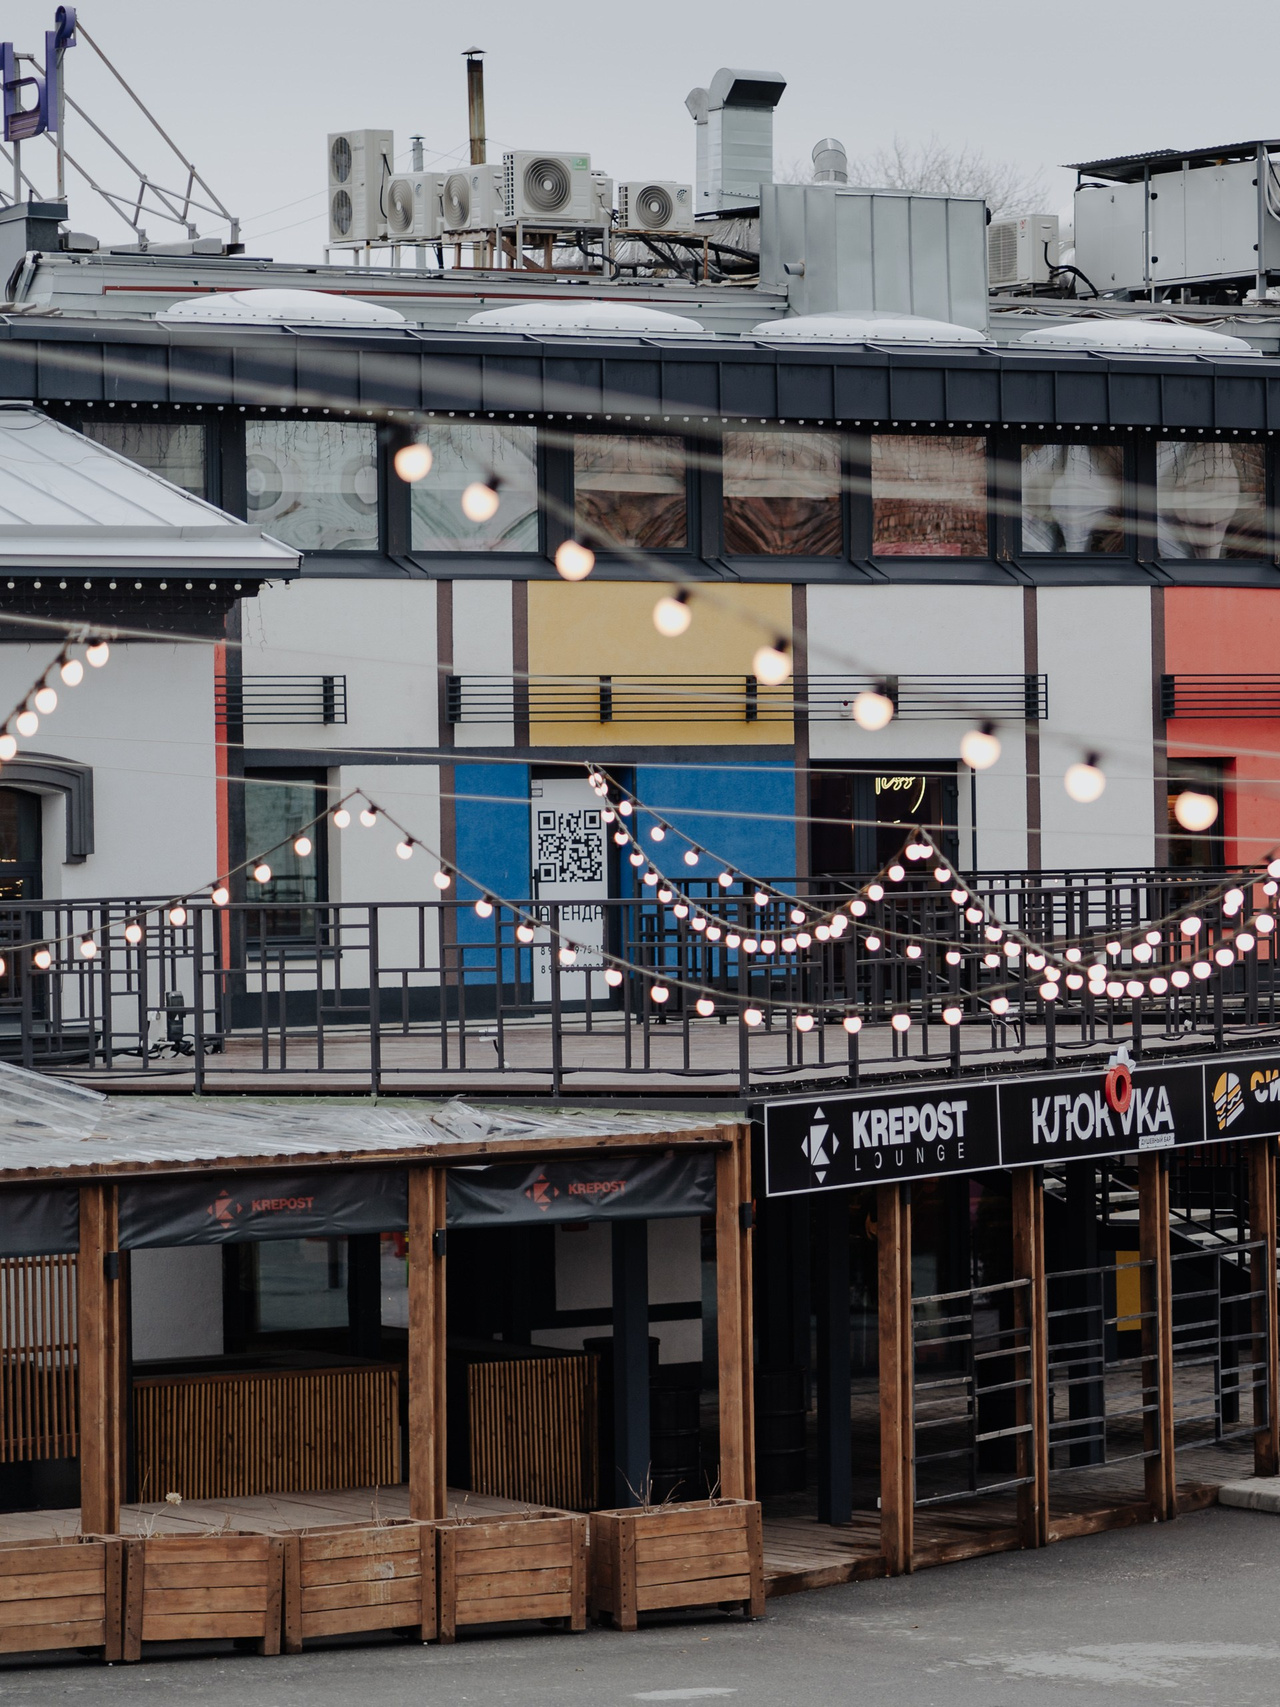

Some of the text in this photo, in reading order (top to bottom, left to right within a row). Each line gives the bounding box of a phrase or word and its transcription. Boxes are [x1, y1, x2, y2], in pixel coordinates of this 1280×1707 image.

[540, 904, 604, 922] АЕНДА
[852, 1100, 968, 1149] KREPOST
[854, 1142, 965, 1171] LOUNGE
[567, 1180, 627, 1196] KREPOST
[251, 1197, 315, 1213] KREPOST
